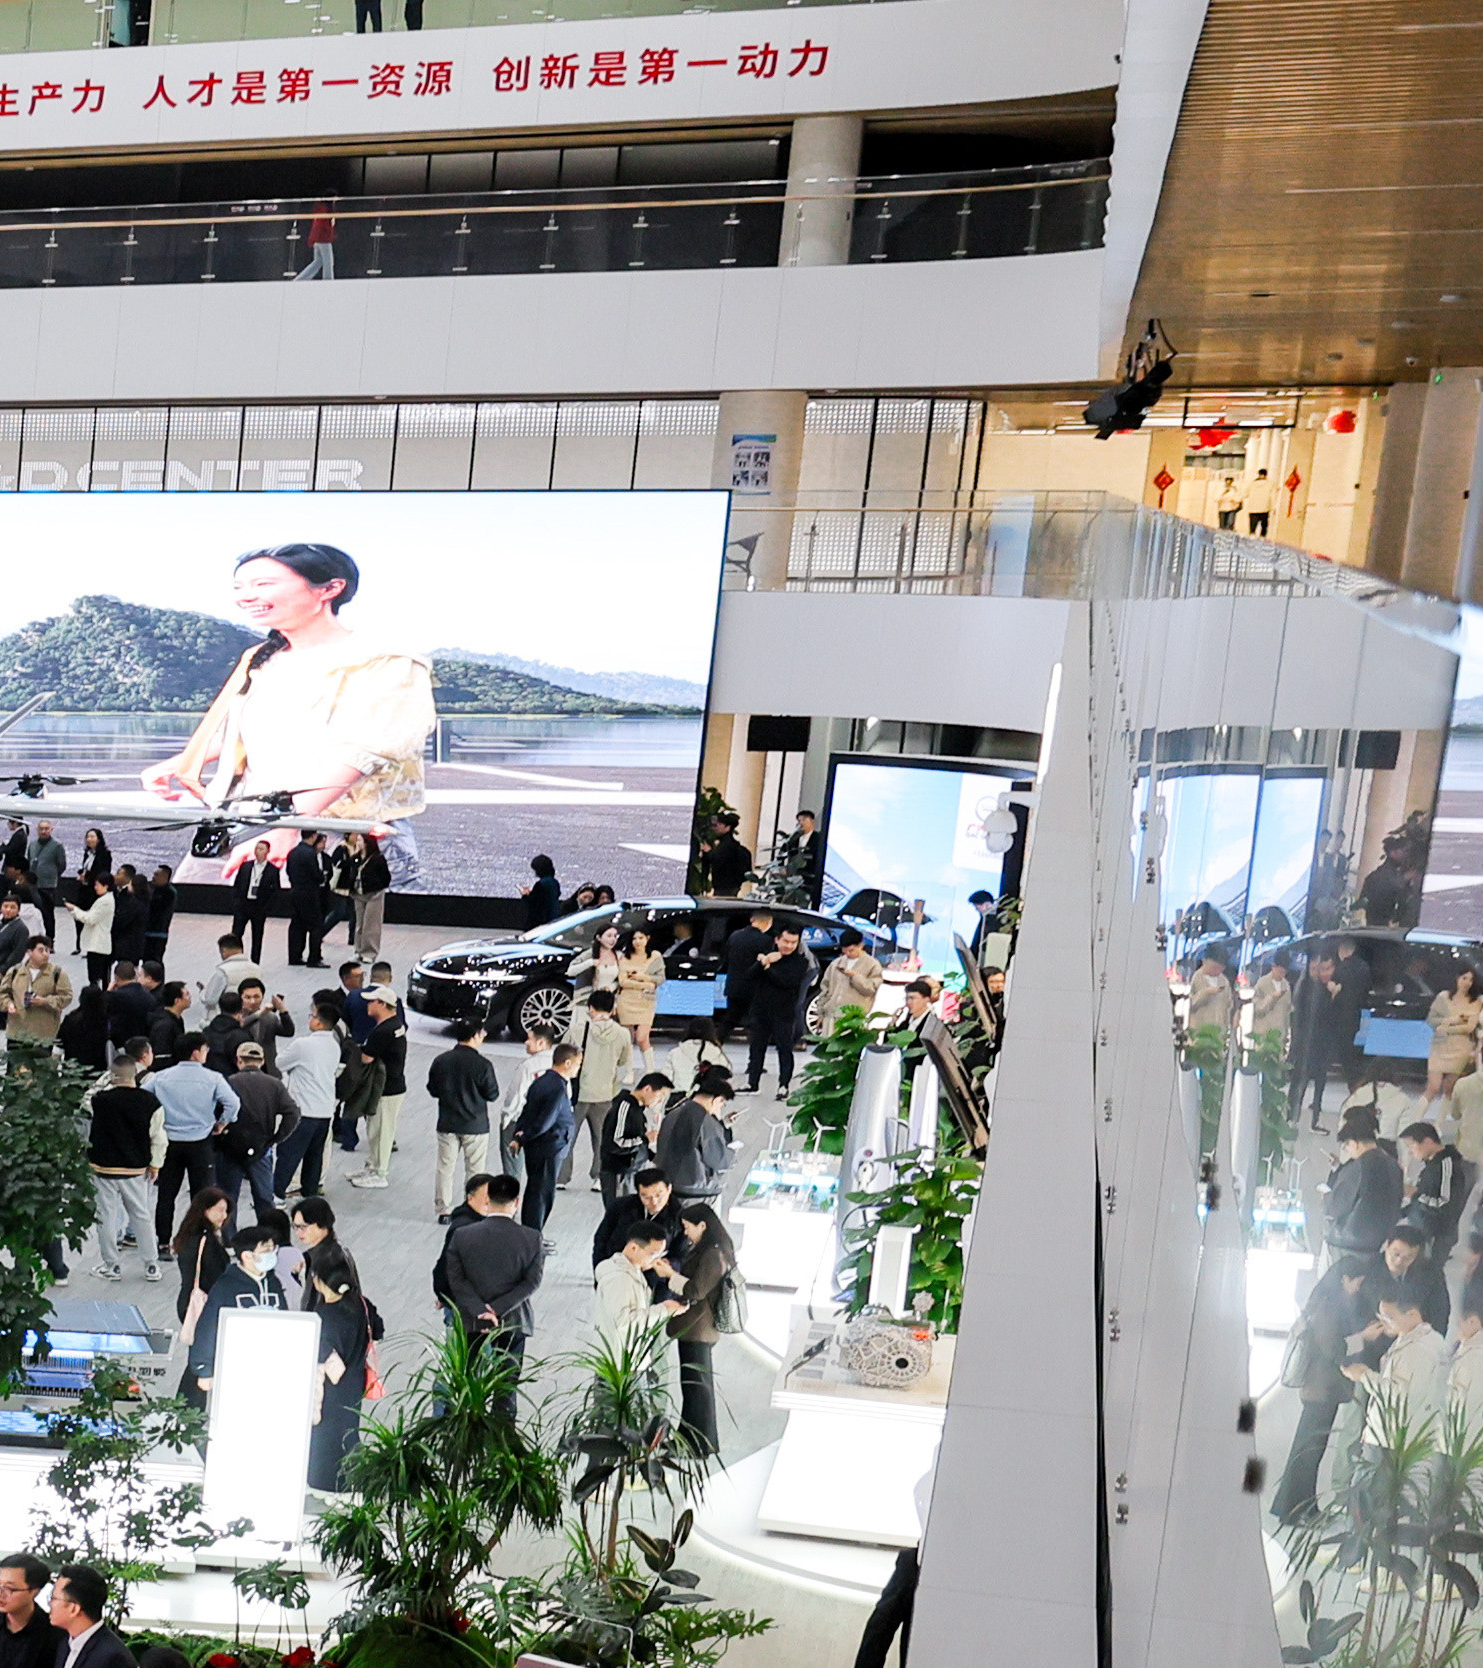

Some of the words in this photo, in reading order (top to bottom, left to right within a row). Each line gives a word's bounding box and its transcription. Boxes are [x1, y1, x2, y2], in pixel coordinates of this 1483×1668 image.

[142, 58, 455, 111] 人才是第一资源
[492, 38, 831, 93] 创新是第一动力
[77, 459, 364, 491] CENTER
